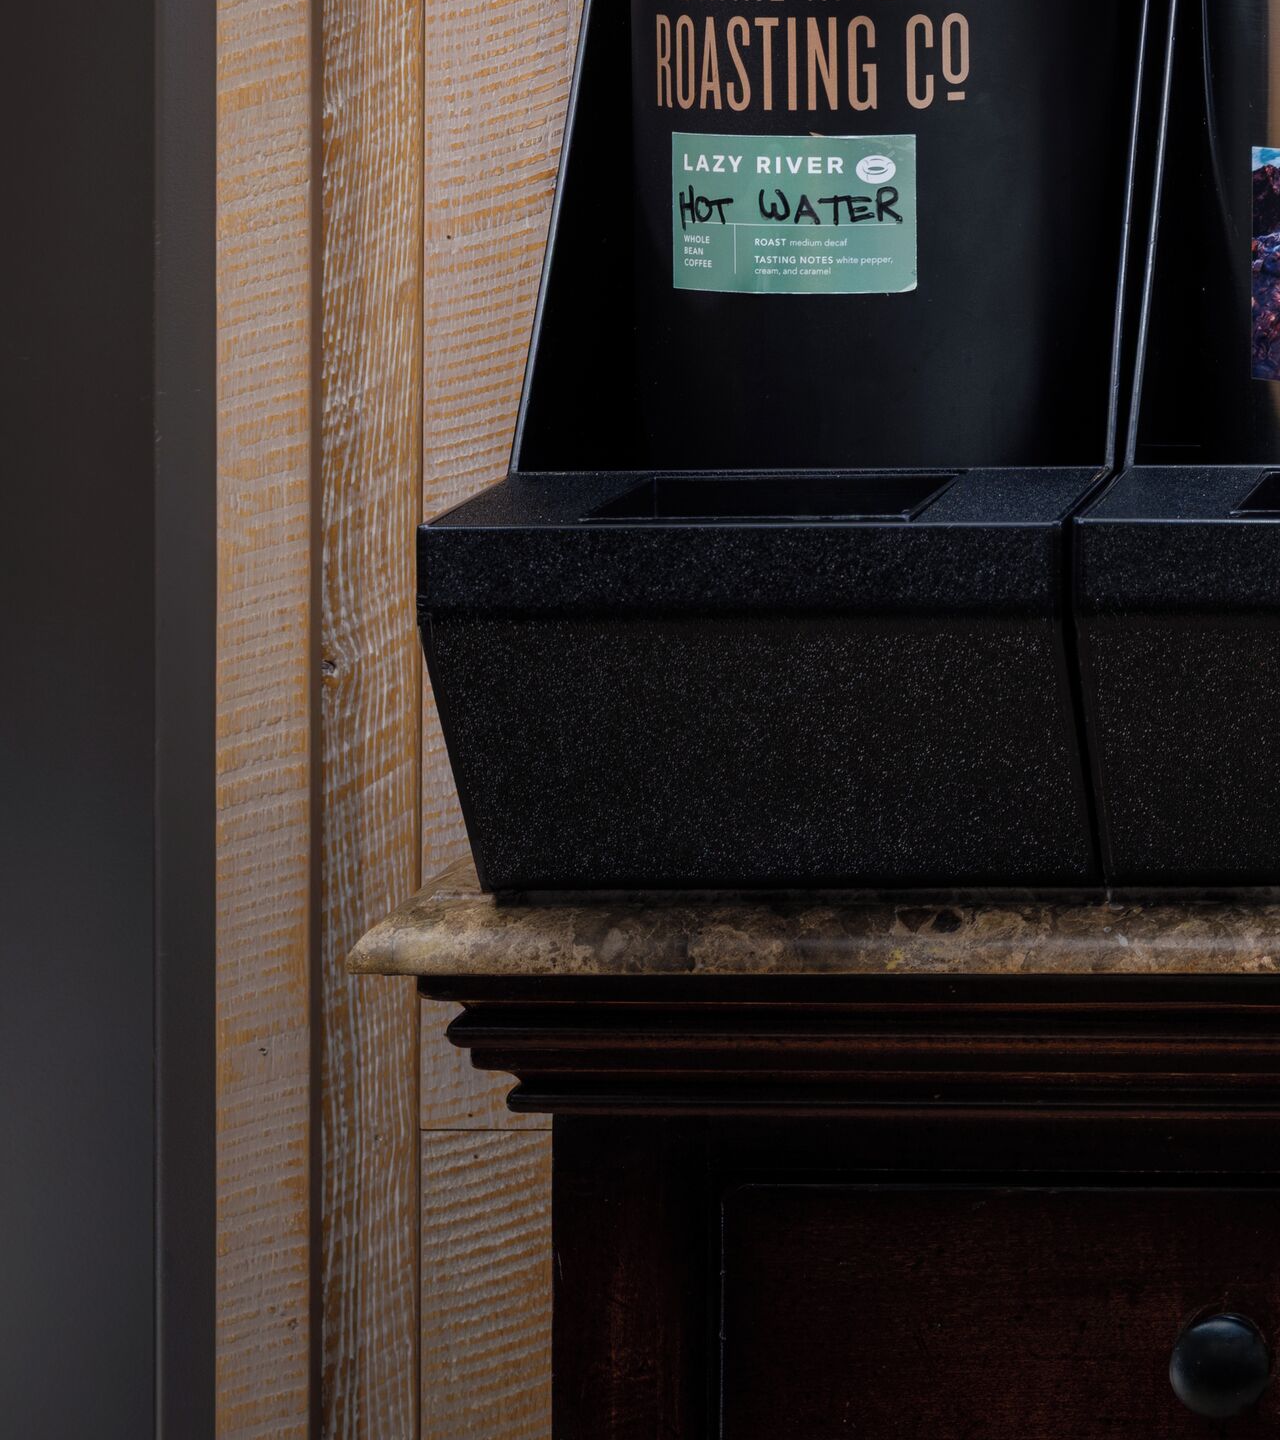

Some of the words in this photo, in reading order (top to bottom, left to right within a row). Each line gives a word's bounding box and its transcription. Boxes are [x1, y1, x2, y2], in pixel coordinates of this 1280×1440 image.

[656, 14, 878, 111] ROASTING
[683, 154, 742, 173] LAZY
[756, 156, 844, 174] RIVER
[679, 185, 734, 231] HOT
[759, 186, 902, 226] WATER
[684, 235, 710, 244] WHOLE
[824, 239, 848, 247] decaf
[684, 247, 703, 255] BEAN
[684, 259, 712, 268] COFFEE
[754, 256, 796, 264] TASTING
[800, 256, 833, 264] NOTES
[860, 257, 893, 266] pepper,
[754, 268, 780, 276] cream,
